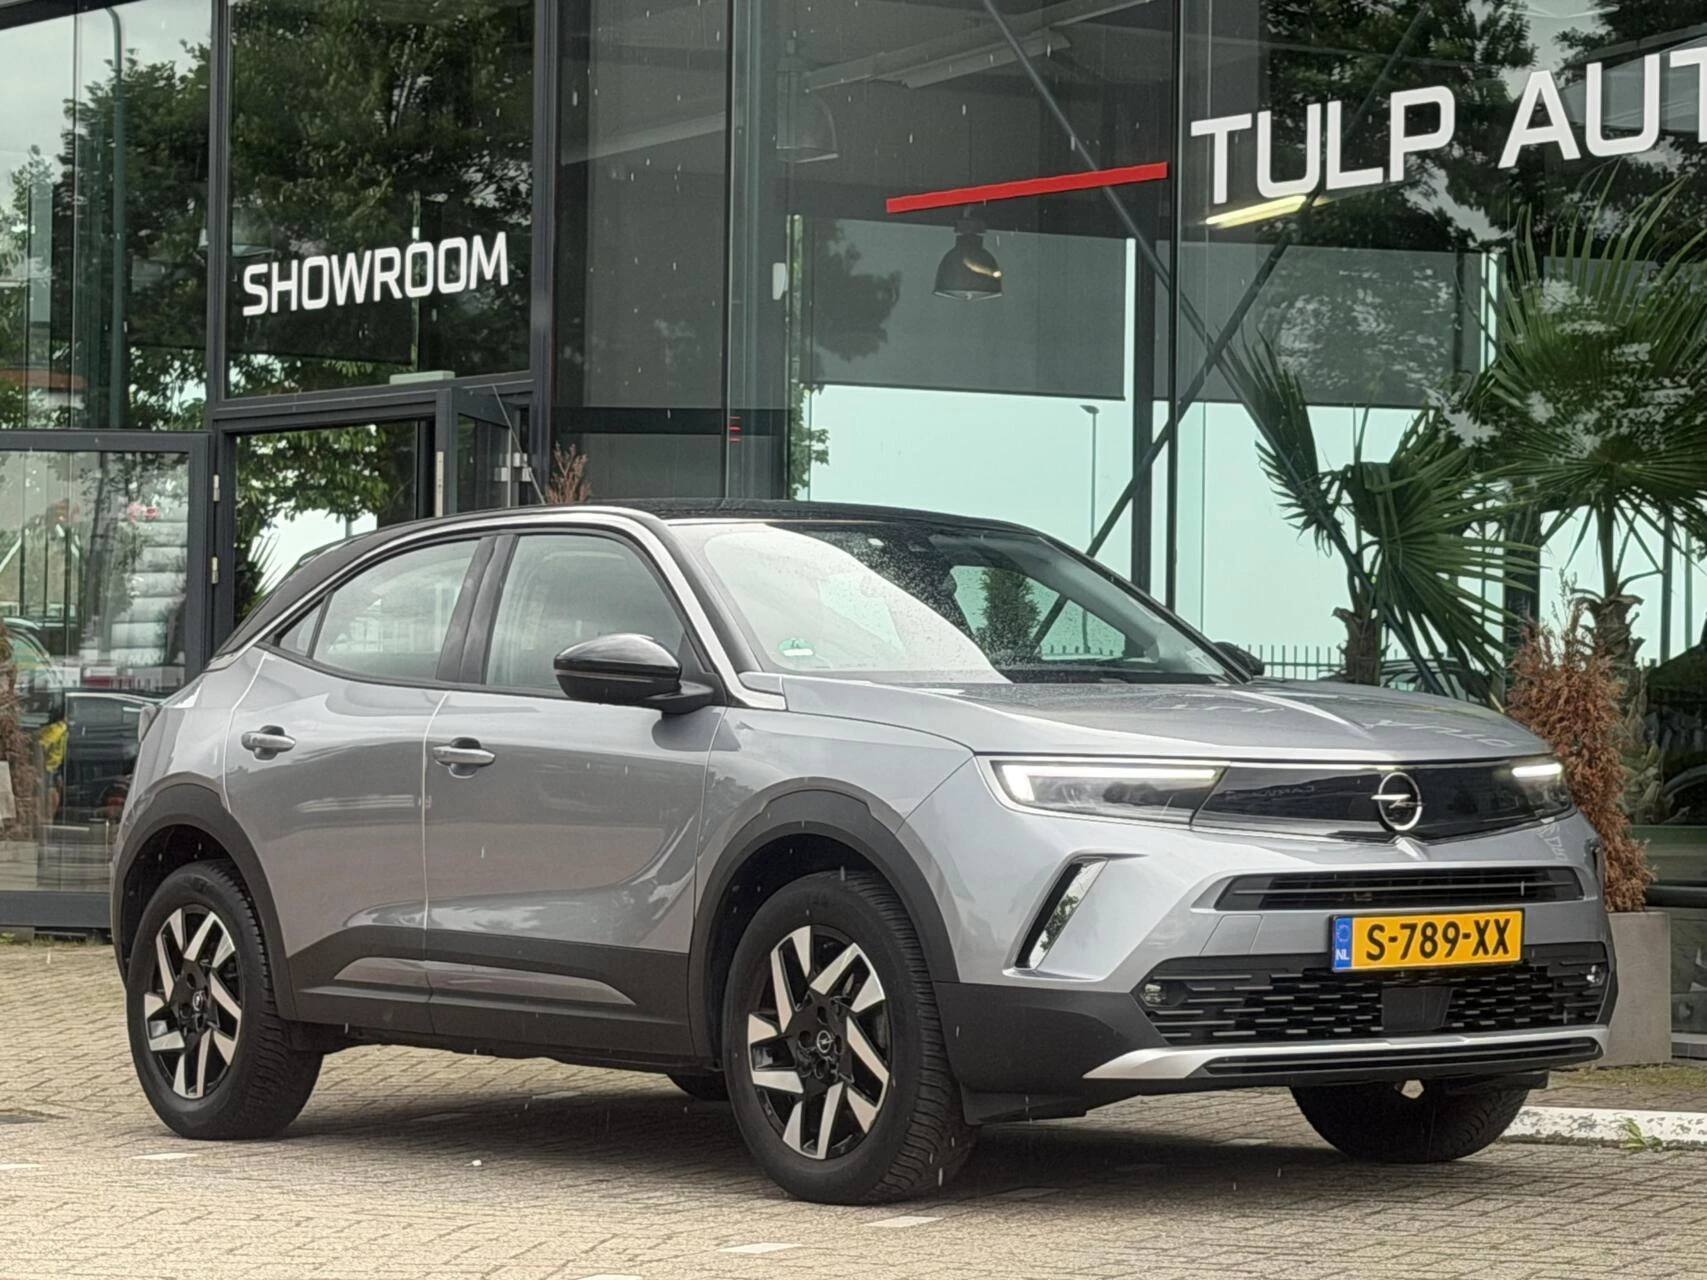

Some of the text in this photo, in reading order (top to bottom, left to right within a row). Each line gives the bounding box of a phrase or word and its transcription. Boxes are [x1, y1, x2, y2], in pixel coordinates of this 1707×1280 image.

[1190, 86, 1455, 205] TULP
[242, 231, 509, 316] SHOWROOM
[1335, 948, 1351, 961] NL
[1366, 918, 1511, 961] S-789-XX
